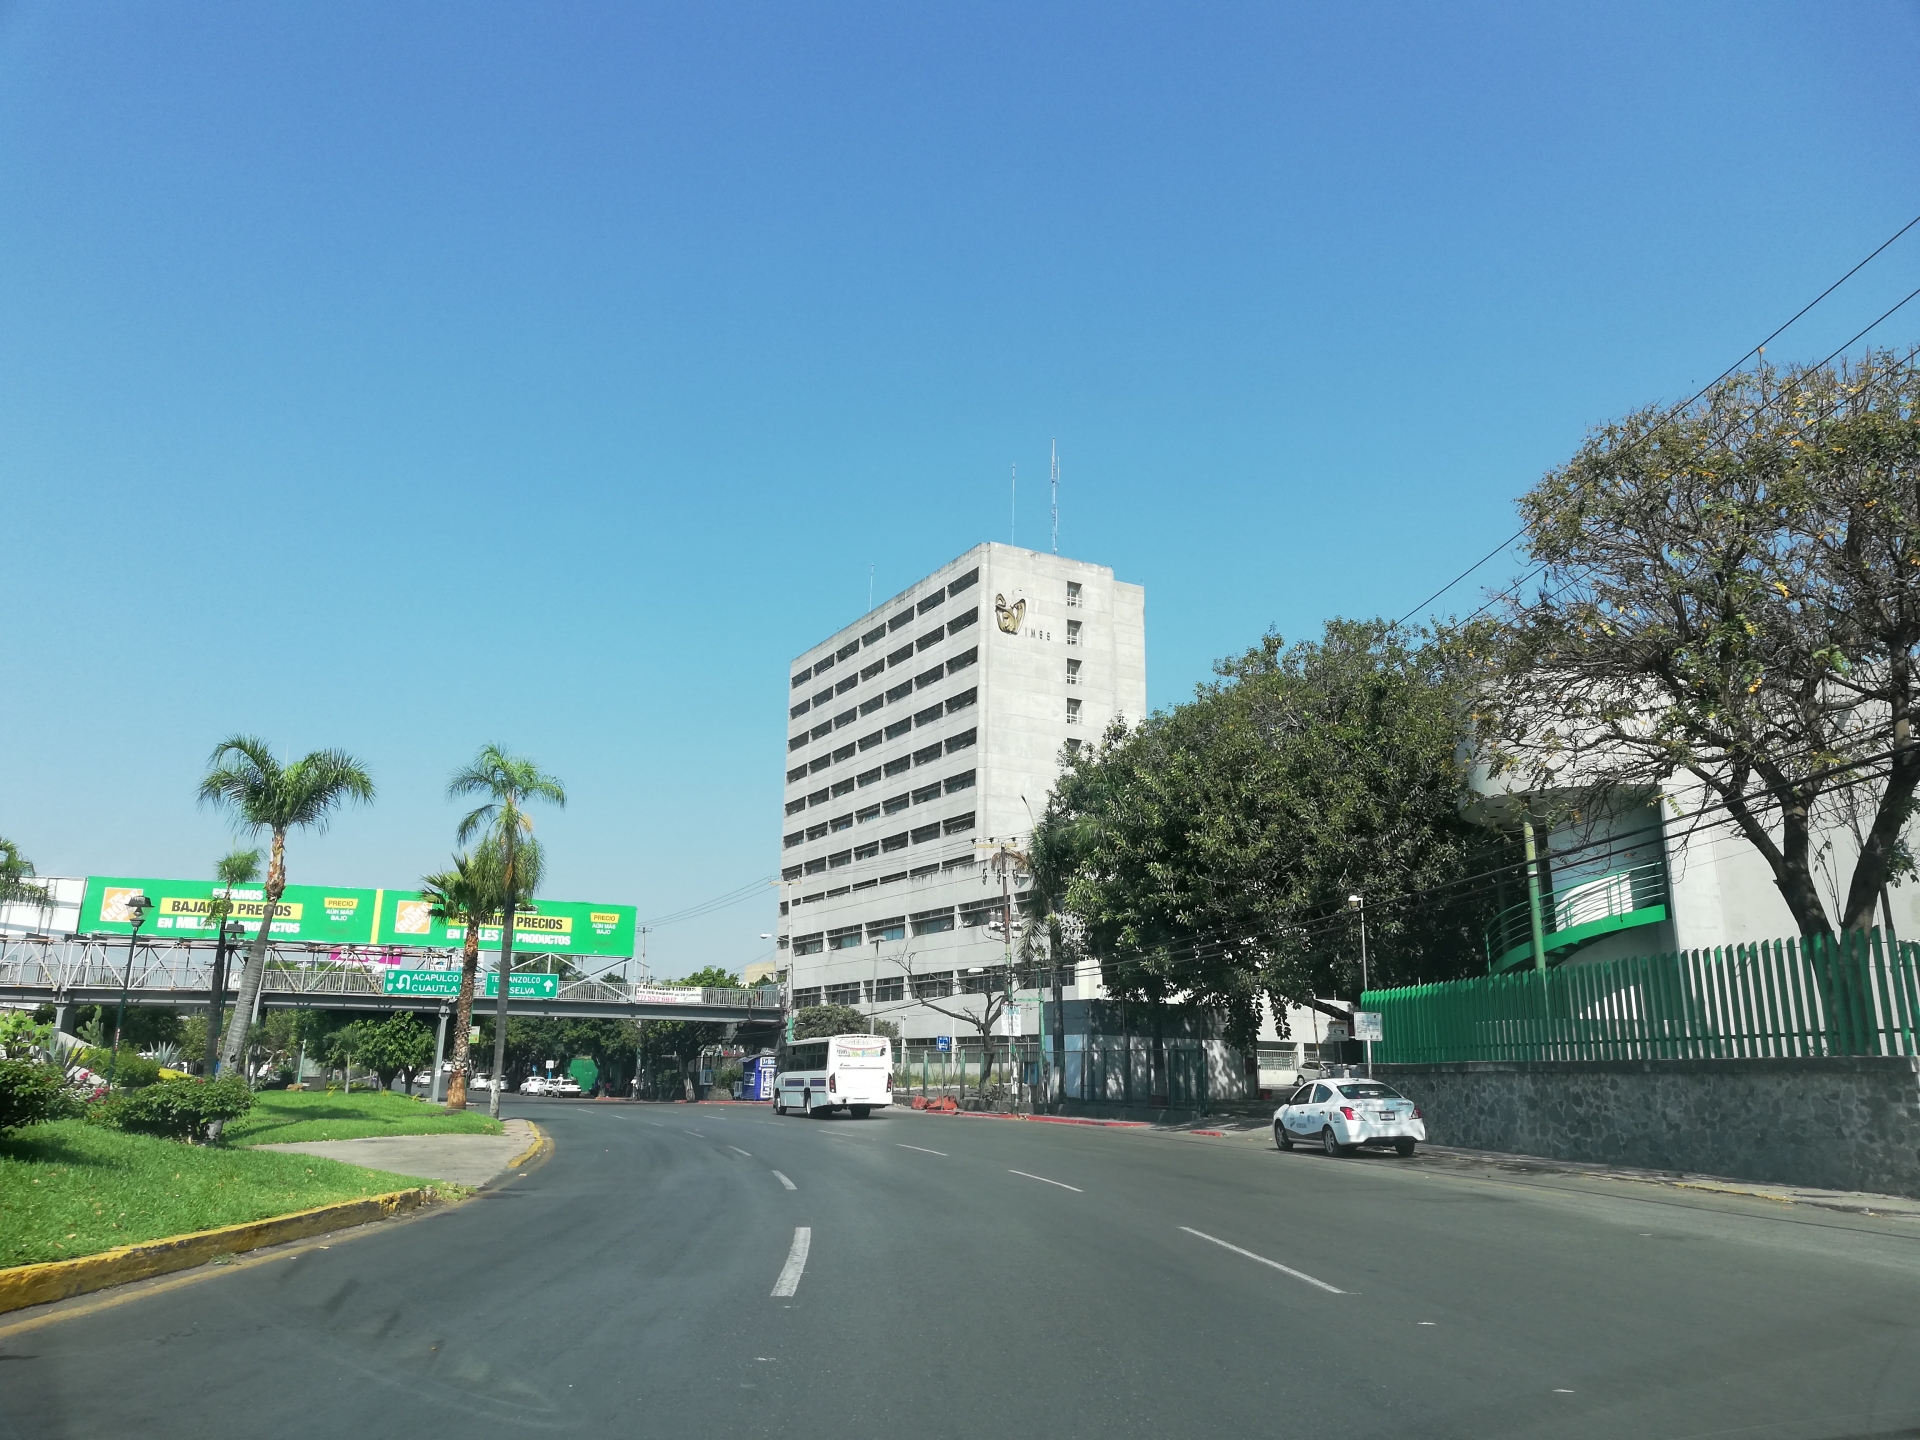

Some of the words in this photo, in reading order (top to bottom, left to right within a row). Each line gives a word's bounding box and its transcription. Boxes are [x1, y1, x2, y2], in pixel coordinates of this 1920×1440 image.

[1025, 627, 1051, 641] IMSS
[171, 900, 235, 915] BAJANO
[593, 913, 616, 921] PRECIO
[157, 917, 174, 929] EN
[176, 916, 217, 930] MILS
[516, 916, 563, 930] PRECIOS
[446, 928, 460, 939] EN
[515, 932, 571, 945] PRODUCTOS
[412, 973, 459, 982] ACAPULCO
[491, 975, 541, 984] TEANZOLCO
[411, 984, 458, 993] CUAUTLA
[509, 986, 535, 994] SELVA
